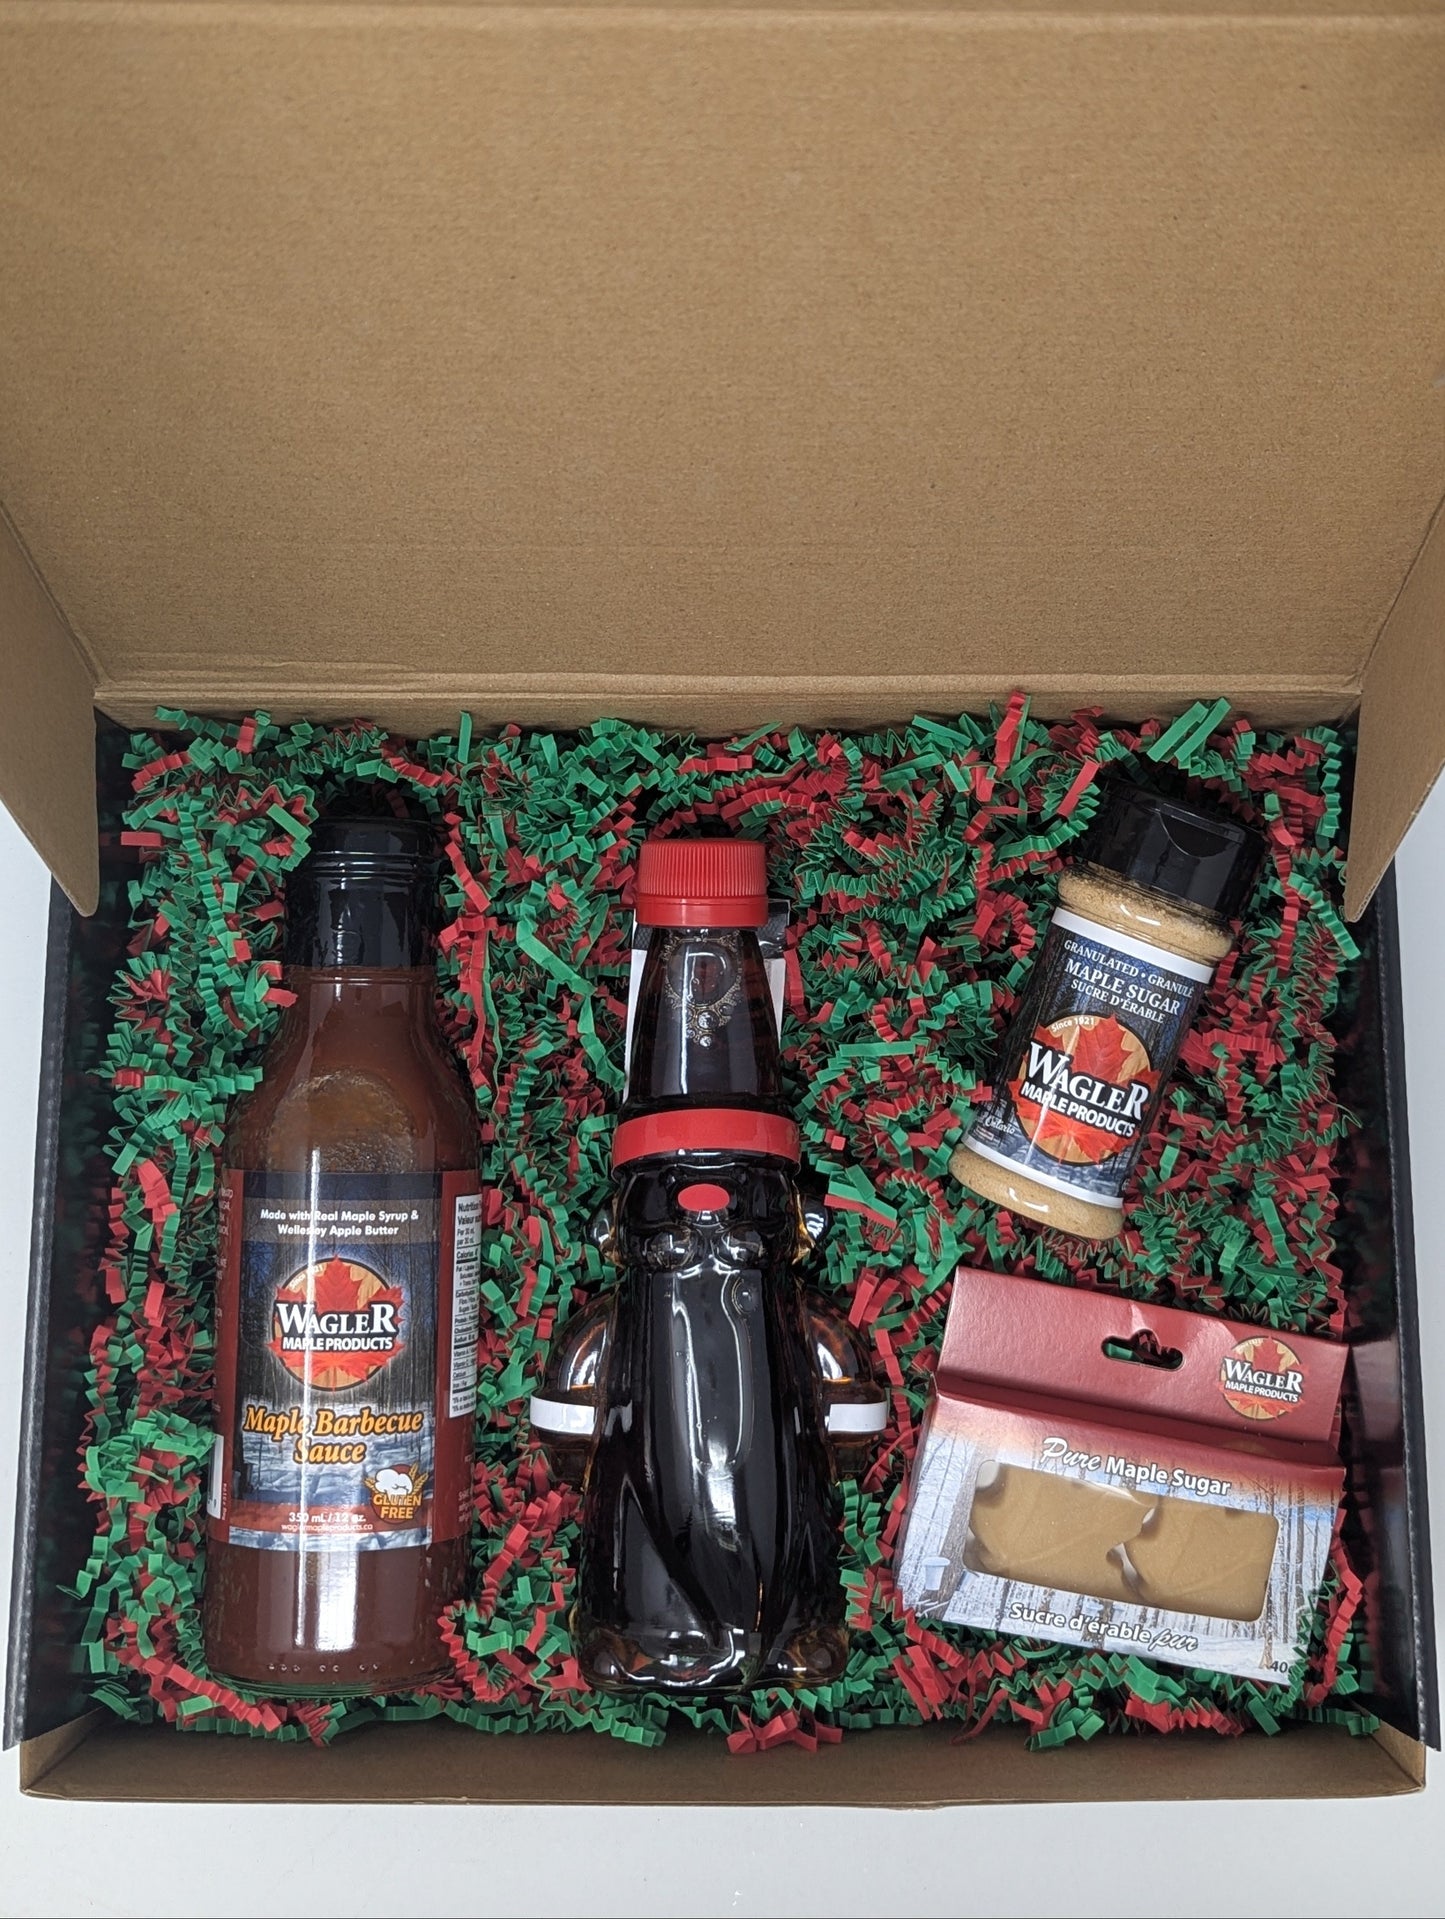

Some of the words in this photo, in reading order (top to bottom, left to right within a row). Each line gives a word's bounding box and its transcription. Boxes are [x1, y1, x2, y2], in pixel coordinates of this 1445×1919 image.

[1064, 939, 1139, 977] GRANULATED
[1148, 974, 1195, 998] GRANULÉ
[1064, 958, 1124, 994] MAPLE
[1126, 985, 1180, 1015] SUGAR
[1071, 979, 1108, 1002] SUCRE
[1110, 995, 1165, 1024] D'ÉRABLE
[1051, 1018, 1073, 1033] Since
[1073, 1017, 1095, 1026] 1921
[1030, 1041, 1149, 1121] WAGLER
[1021, 1081, 1067, 1114] MAPLE
[1066, 1100, 1136, 1138] PRODUCTS
[260, 1208, 286, 1220] Made
[288, 1210, 310, 1221] with
[313, 1210, 339, 1222] Real
[341, 1211, 376, 1224] Maple
[378, 1210, 409, 1224] Syrup
[411, 1209, 419, 1220] &
[329, 1225, 362, 1238] Apple
[364, 1224, 399, 1236] Butter
[276, 1302, 398, 1335] WAGLER
[282, 1335, 325, 1351] MAPLE
[325, 1335, 393, 1350] PRODUCTS
[1223, 1357, 1304, 1394] WAGLER
[1225, 1380, 1255, 1395] MAPLE
[1254, 1386, 1299, 1403] PRODUCTS
[243, 1406, 311, 1438] Maple
[316, 1406, 423, 1434] Barbecue
[294, 1438, 366, 1463] Sauce
[1041, 1437, 1101, 1471] Pure
[1105, 1456, 1169, 1489] Maple
[1171, 1469, 1231, 1497] Sugar
[373, 1494, 422, 1506] GLUTEN
[380, 1506, 414, 1519] FREE
[281, 1523, 374, 1533] waglrmapleproducts.ca
[288, 1511, 310, 1523] 350
[1008, 1602, 1066, 1629] Sucre
[1069, 1612, 1151, 1646] d'érable
[1148, 1628, 1199, 1653] pur
[1270, 1660, 1289, 1674] 40
